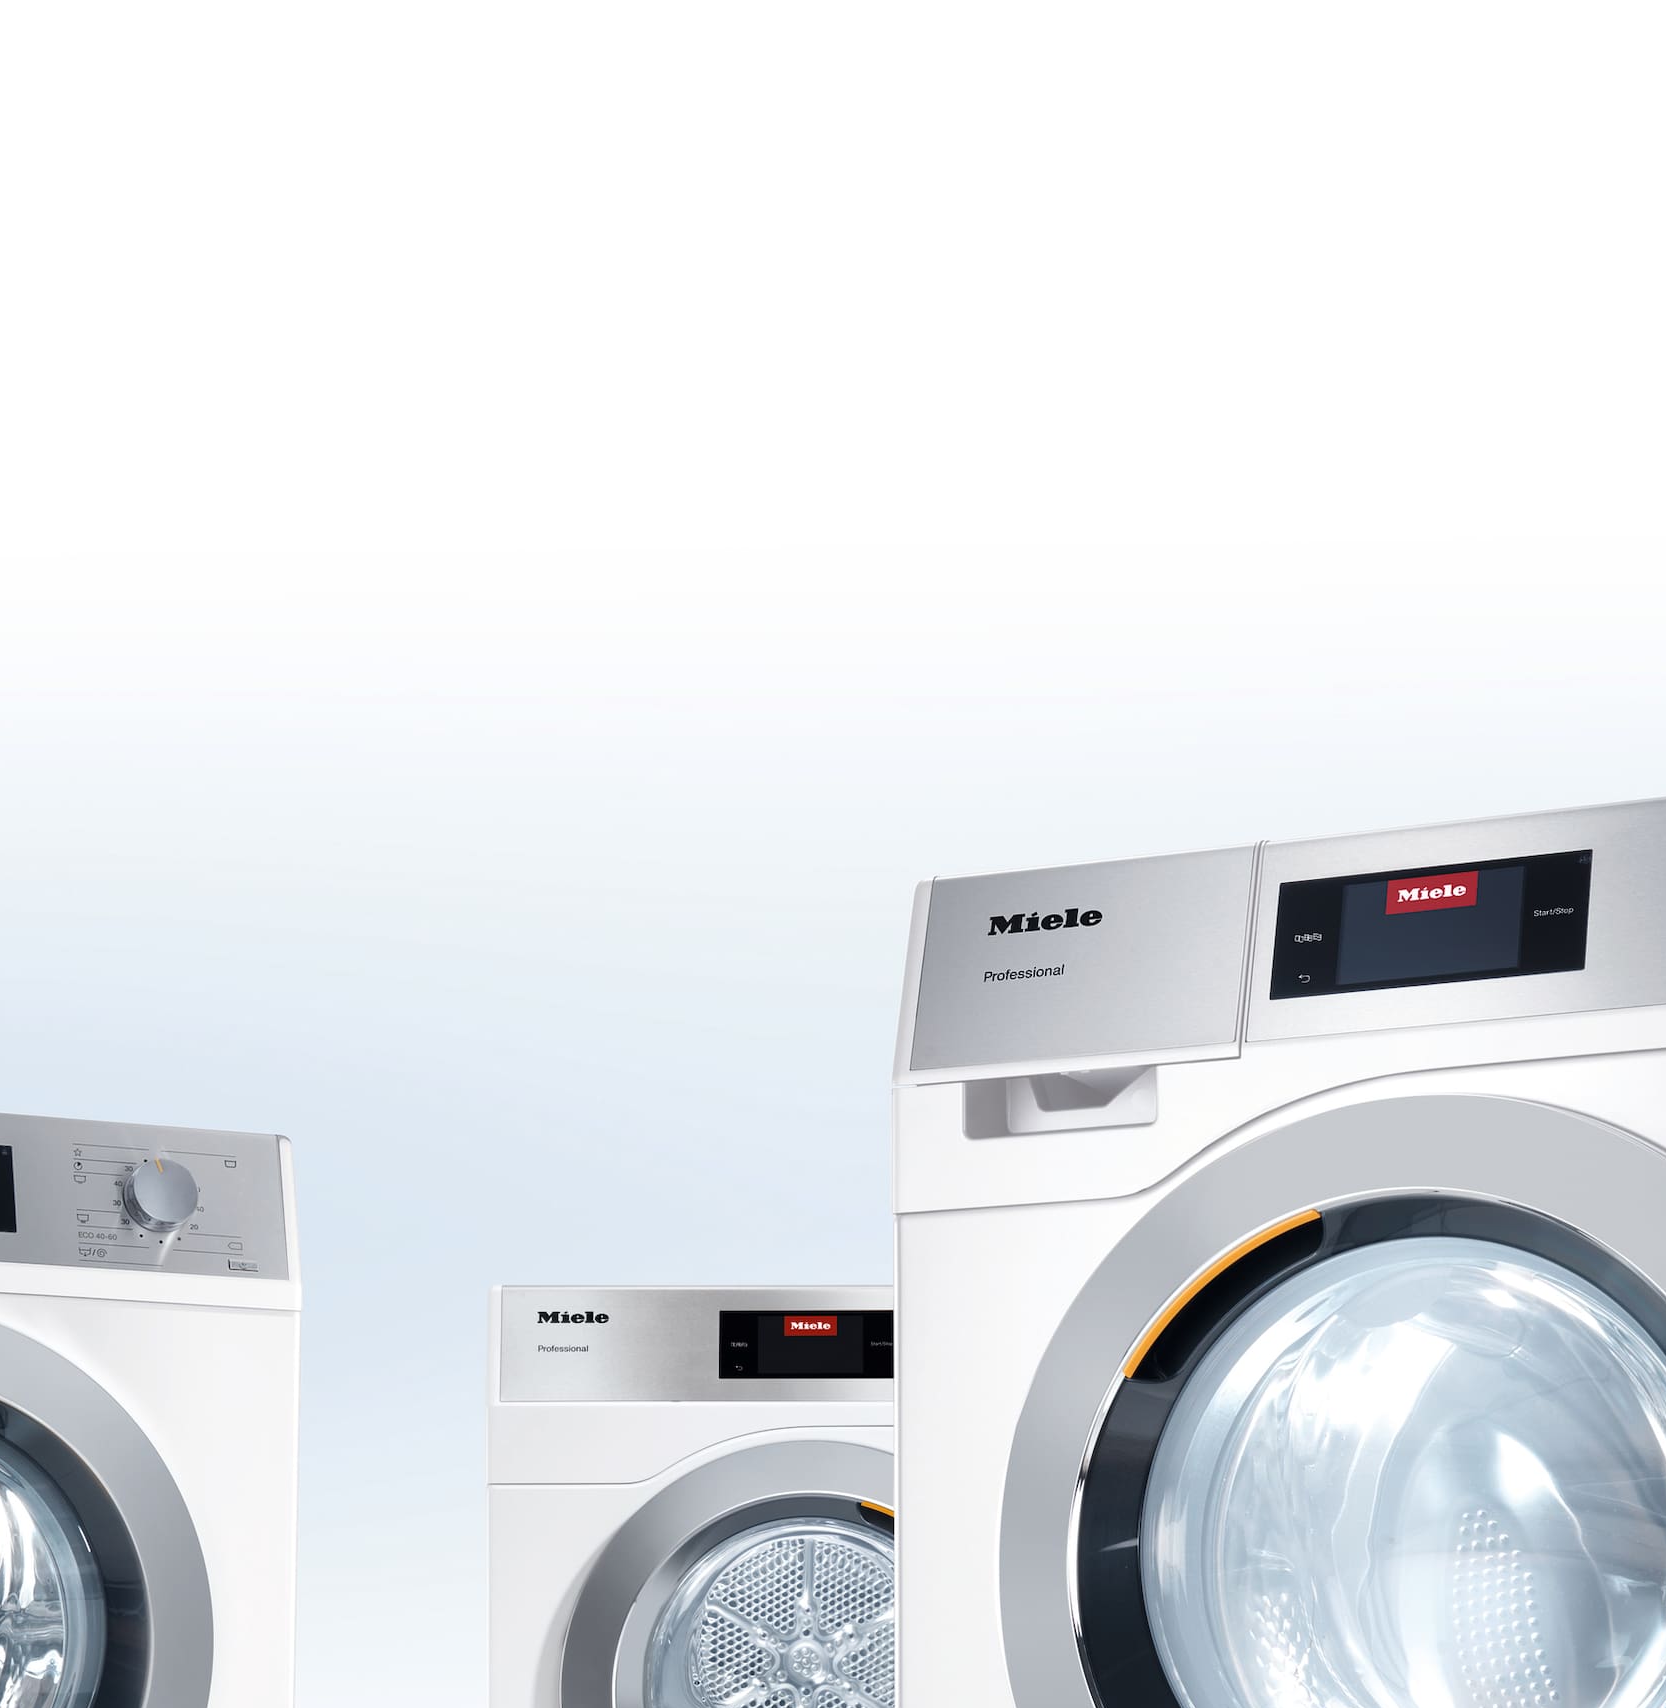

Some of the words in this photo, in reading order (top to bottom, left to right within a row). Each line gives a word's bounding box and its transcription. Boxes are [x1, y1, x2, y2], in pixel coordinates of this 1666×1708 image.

[1397, 884, 1467, 902] Miele
[1533, 907, 1574, 917] Start/Stop
[987, 908, 1103, 936] Miele
[983, 963, 1065, 983] Professional
[537, 1311, 609, 1324] Miele
[790, 1321, 831, 1330] Miele
[537, 1345, 589, 1353] Professional
